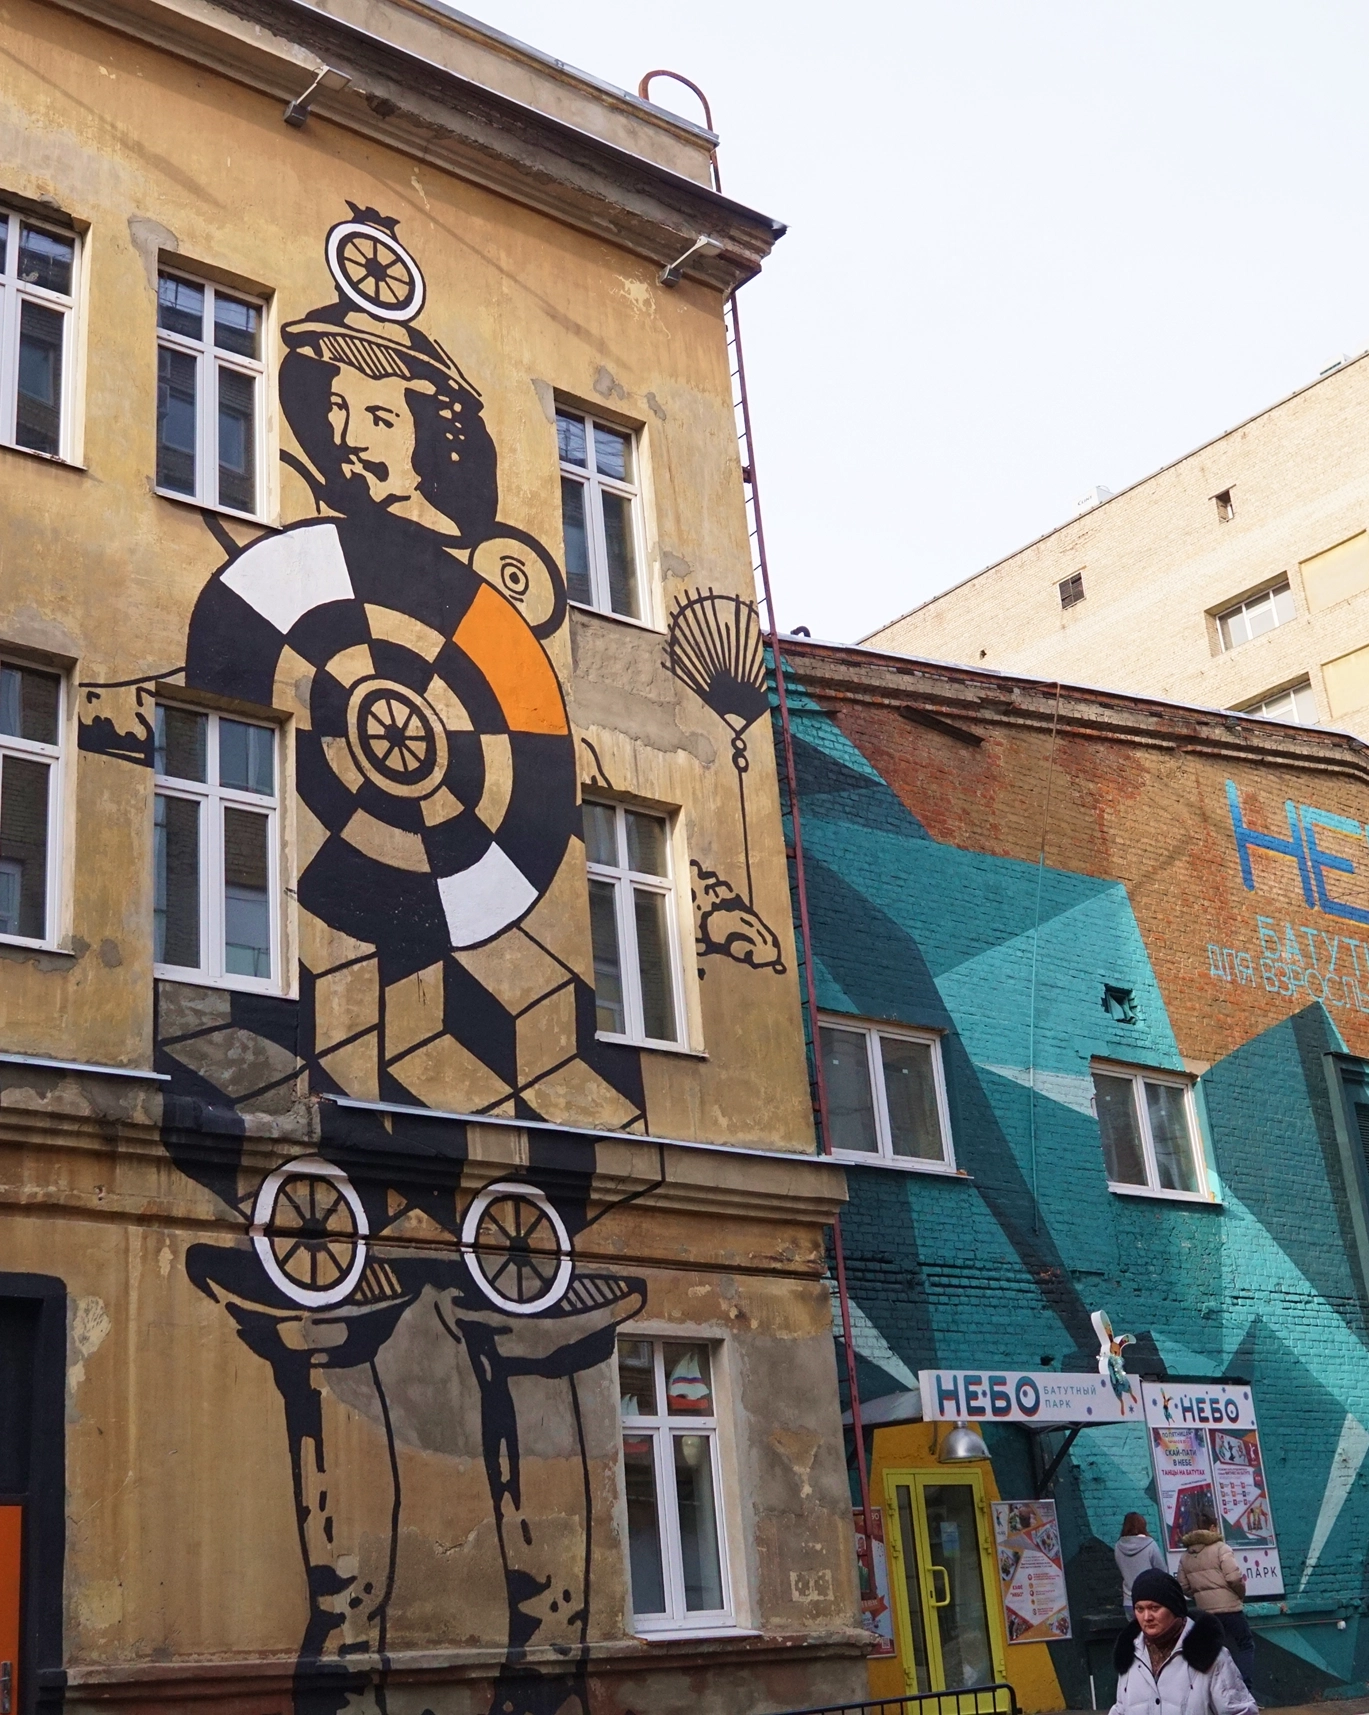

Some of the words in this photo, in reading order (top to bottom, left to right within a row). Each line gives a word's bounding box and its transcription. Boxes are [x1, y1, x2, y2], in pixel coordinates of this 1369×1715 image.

[1225, 778, 1369, 927] НЕ
[1207, 943, 1256, 987] ДЛЯ
[935, 1373, 1041, 1418] НЕБО
[1043, 1384, 1097, 1397] БАТУТНЫЙ
[1044, 1398, 1072, 1409] ПАРК
[1180, 1397, 1240, 1424] НЕБО
[1165, 1447, 1197, 1456] СКАЙ-ПАТИ
[1246, 1567, 1278, 1579] ПАРК
